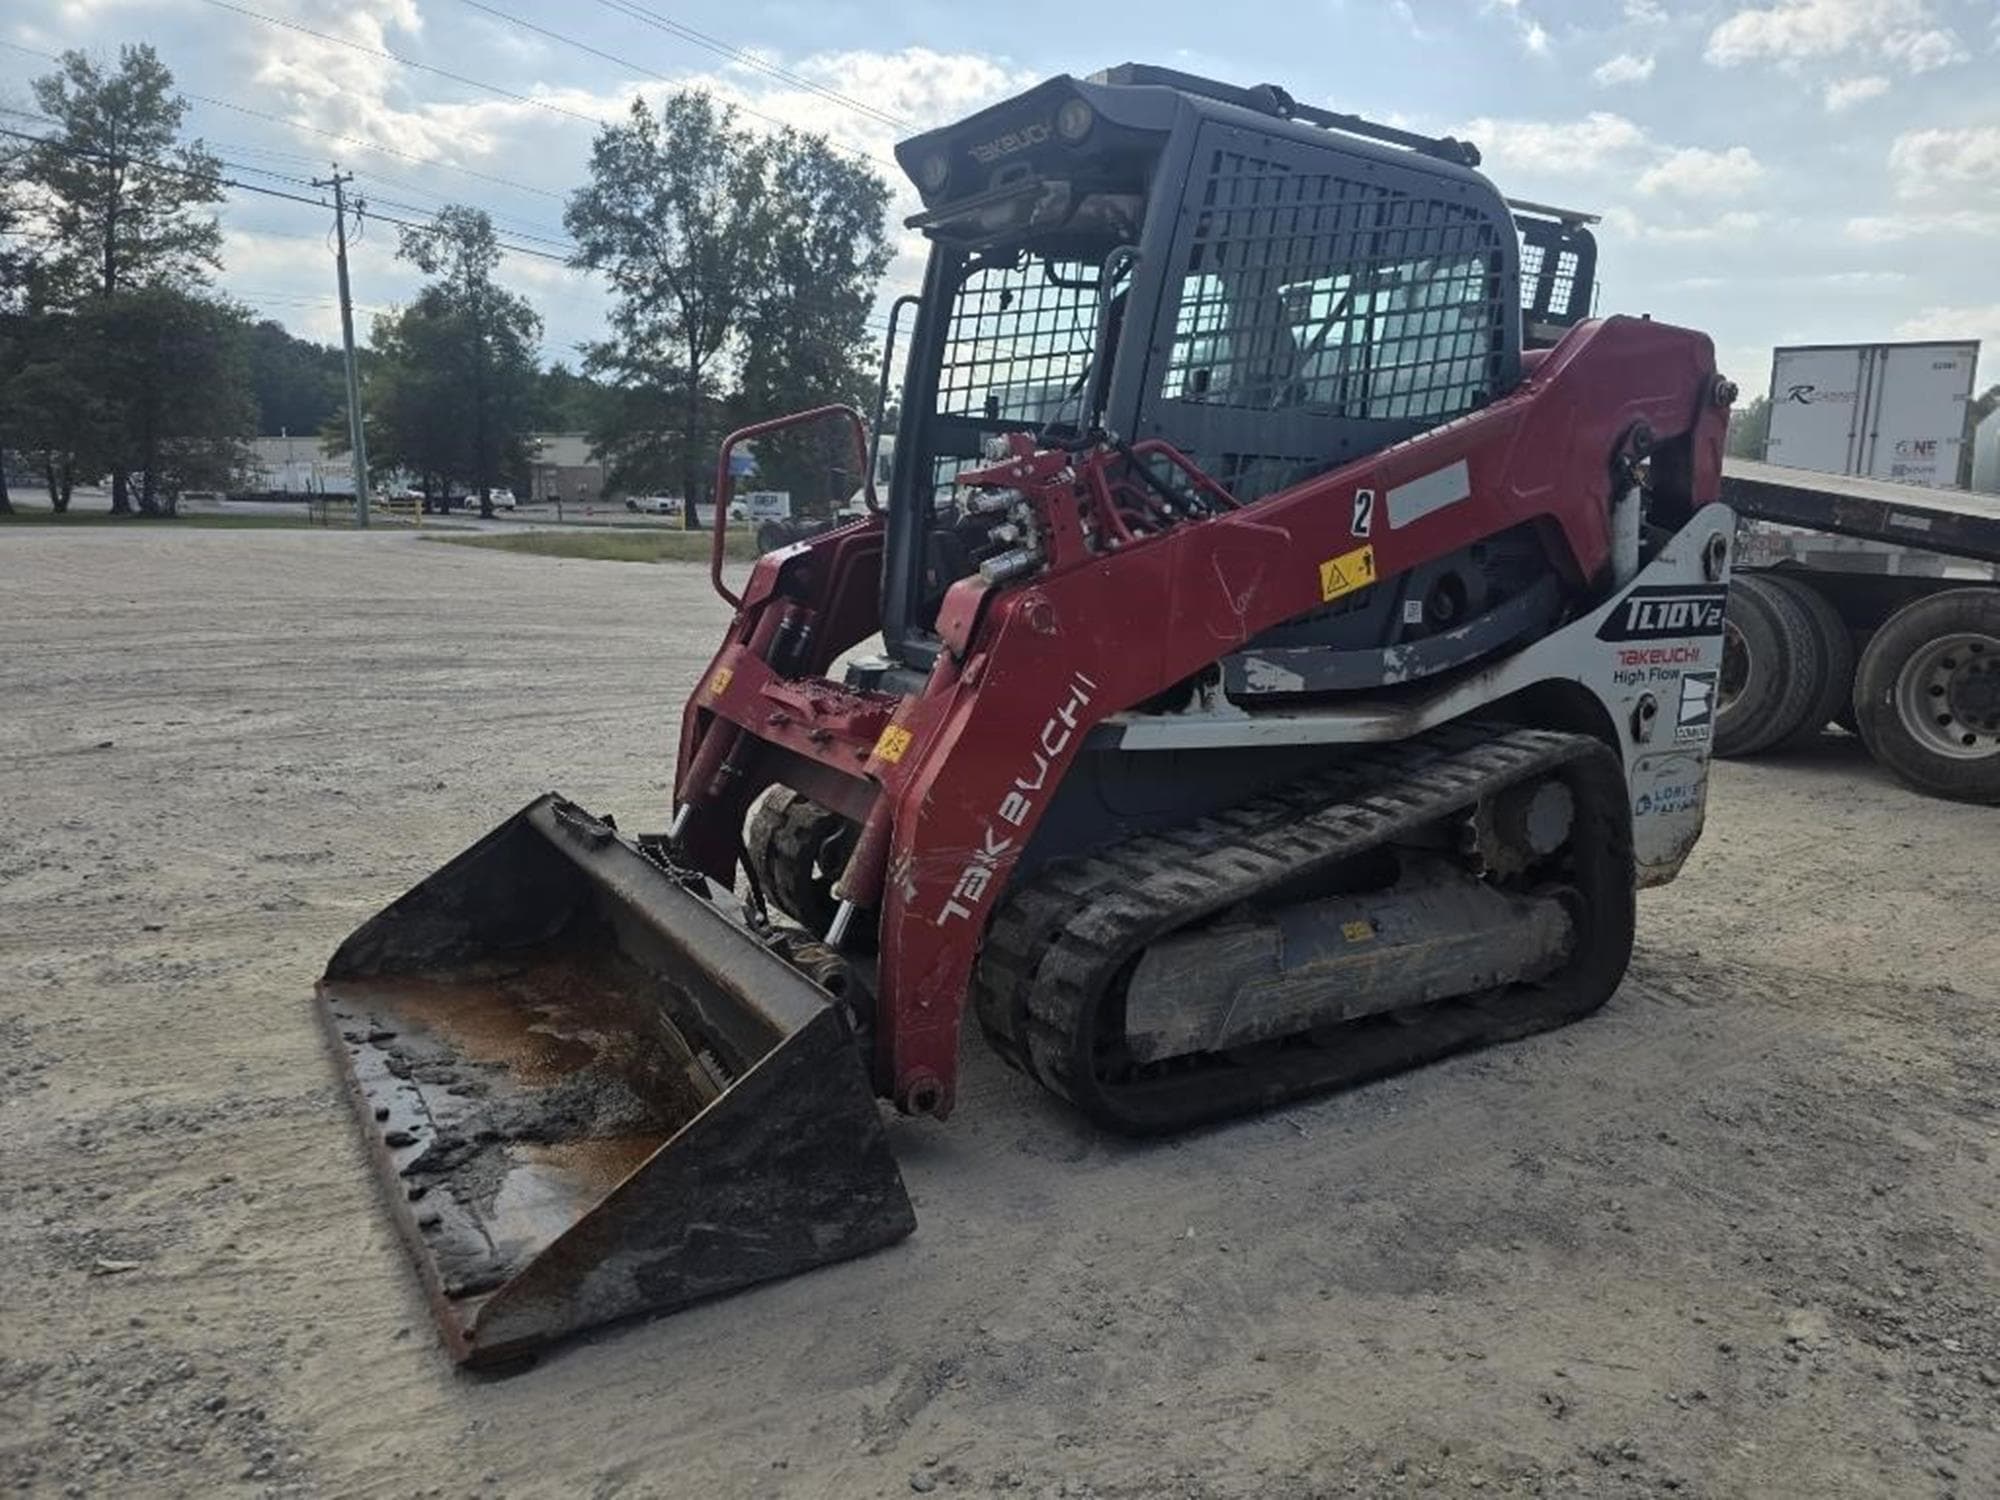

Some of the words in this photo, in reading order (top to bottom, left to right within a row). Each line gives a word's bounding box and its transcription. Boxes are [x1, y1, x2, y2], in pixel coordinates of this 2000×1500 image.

[967, 122, 1053, 163] TAKEUC
[1353, 491, 1372, 533] 2
[1625, 597, 1723, 631] TL10V2
[1618, 647, 1700, 665] TAKEUCHI
[1613, 669, 1645, 686] High
[1649, 666, 1681, 682] Flow
[936, 671, 1098, 926] TAKEUCHI
